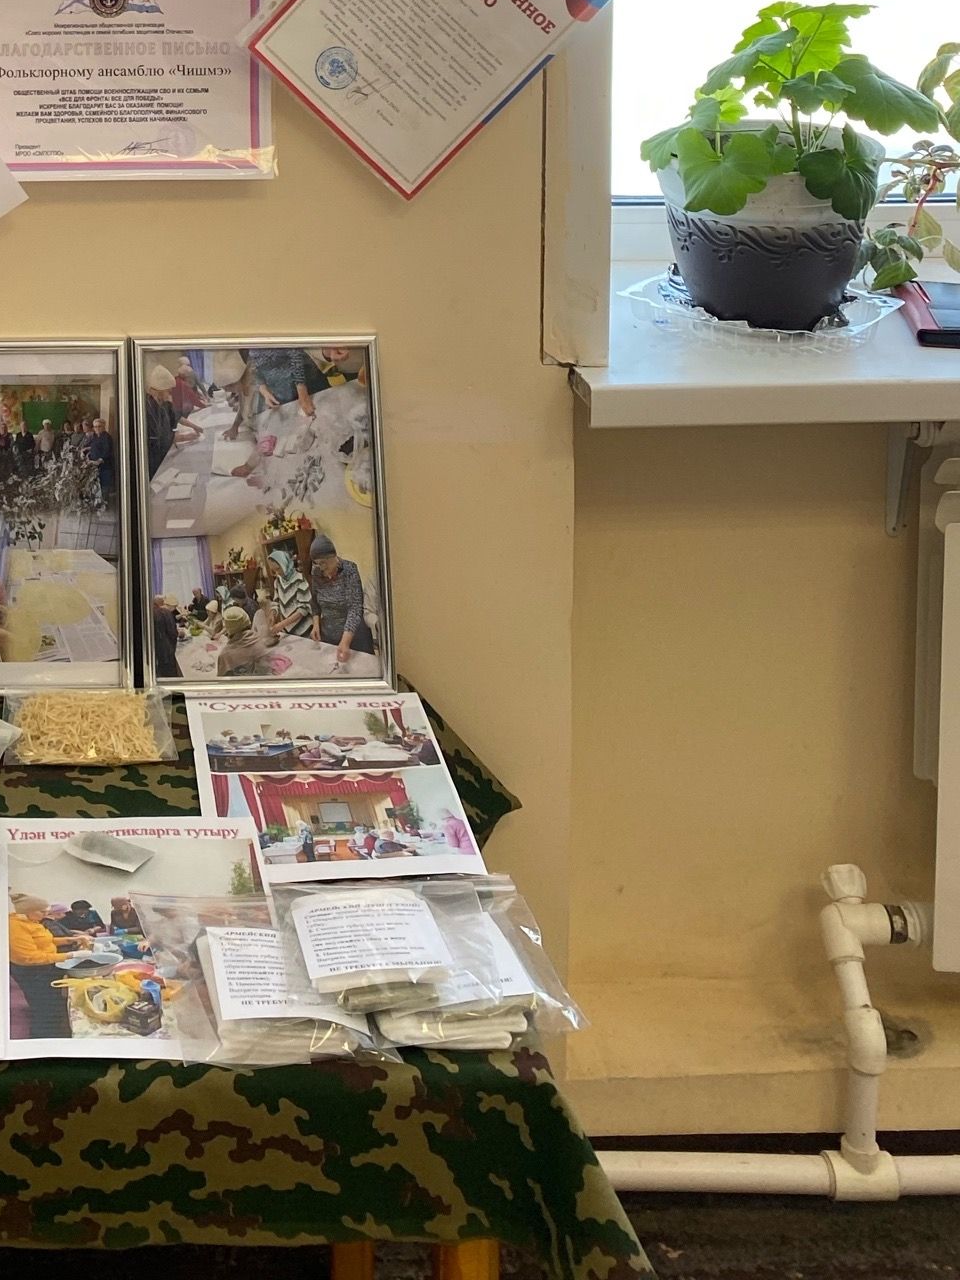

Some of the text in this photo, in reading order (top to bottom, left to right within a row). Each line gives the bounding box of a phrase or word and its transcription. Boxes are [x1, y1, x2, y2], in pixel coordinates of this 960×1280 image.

[162, 41, 229, 55] ПИСЬМО
[98, 64, 164, 77] ансамблю
[168, 64, 231, 77] «Чишмэ»
[198, 700, 406, 711] "Сухой душ" ясау
[7, 828, 46, 841] Үлән
[51, 830, 75, 839] чәе
[186, 828, 239, 839] тутыру
